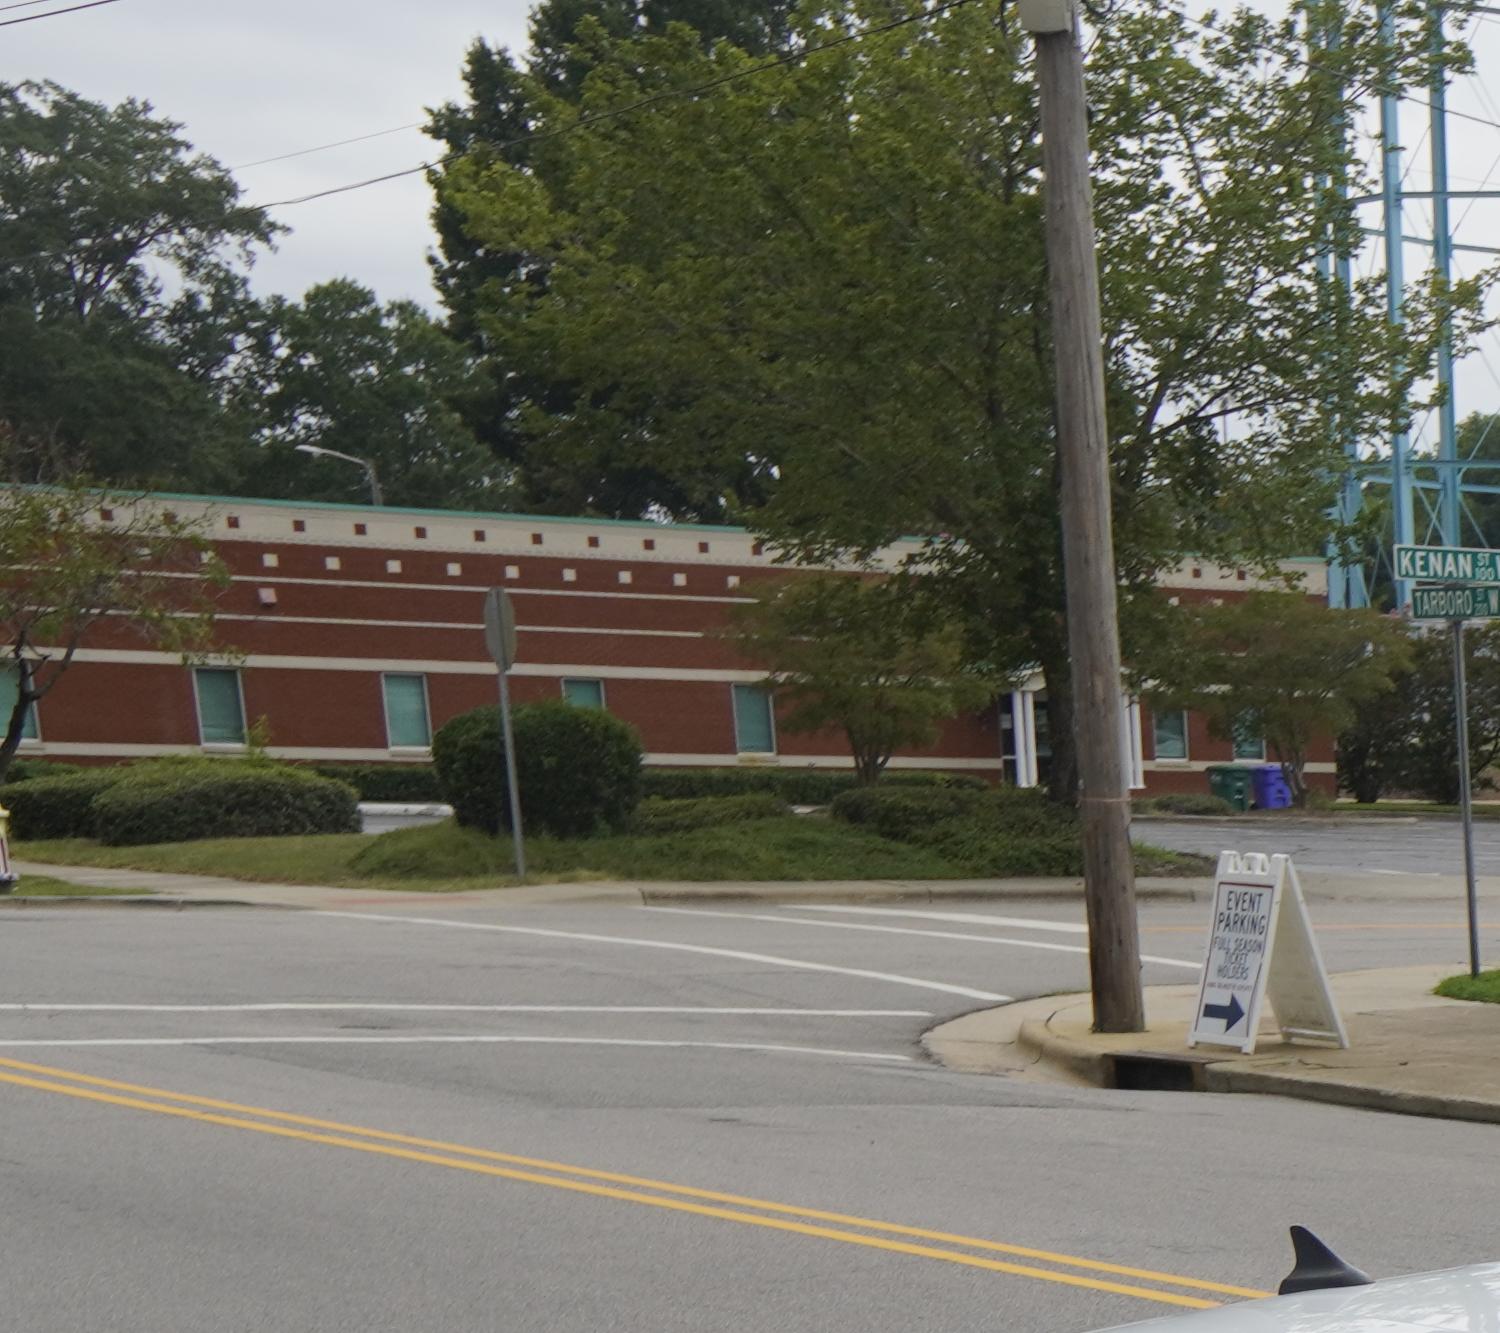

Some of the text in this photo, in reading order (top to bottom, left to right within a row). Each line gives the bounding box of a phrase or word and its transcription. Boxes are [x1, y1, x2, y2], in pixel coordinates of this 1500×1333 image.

[1400, 550, 1473, 579] KENAN
[1477, 552, 1491, 566] ST
[1474, 567, 1495, 581] 100
[1414, 589, 1473, 616] TARBORO
[1488, 589, 1498, 615] W
[1226, 890, 1264, 914] EVENT
[1216, 911, 1267, 936] PARKING
[1213, 936, 1263, 954] FULL SEASON
[1224, 951, 1249, 966] TICKET
[1216, 963, 1250, 981] HOLDERS
